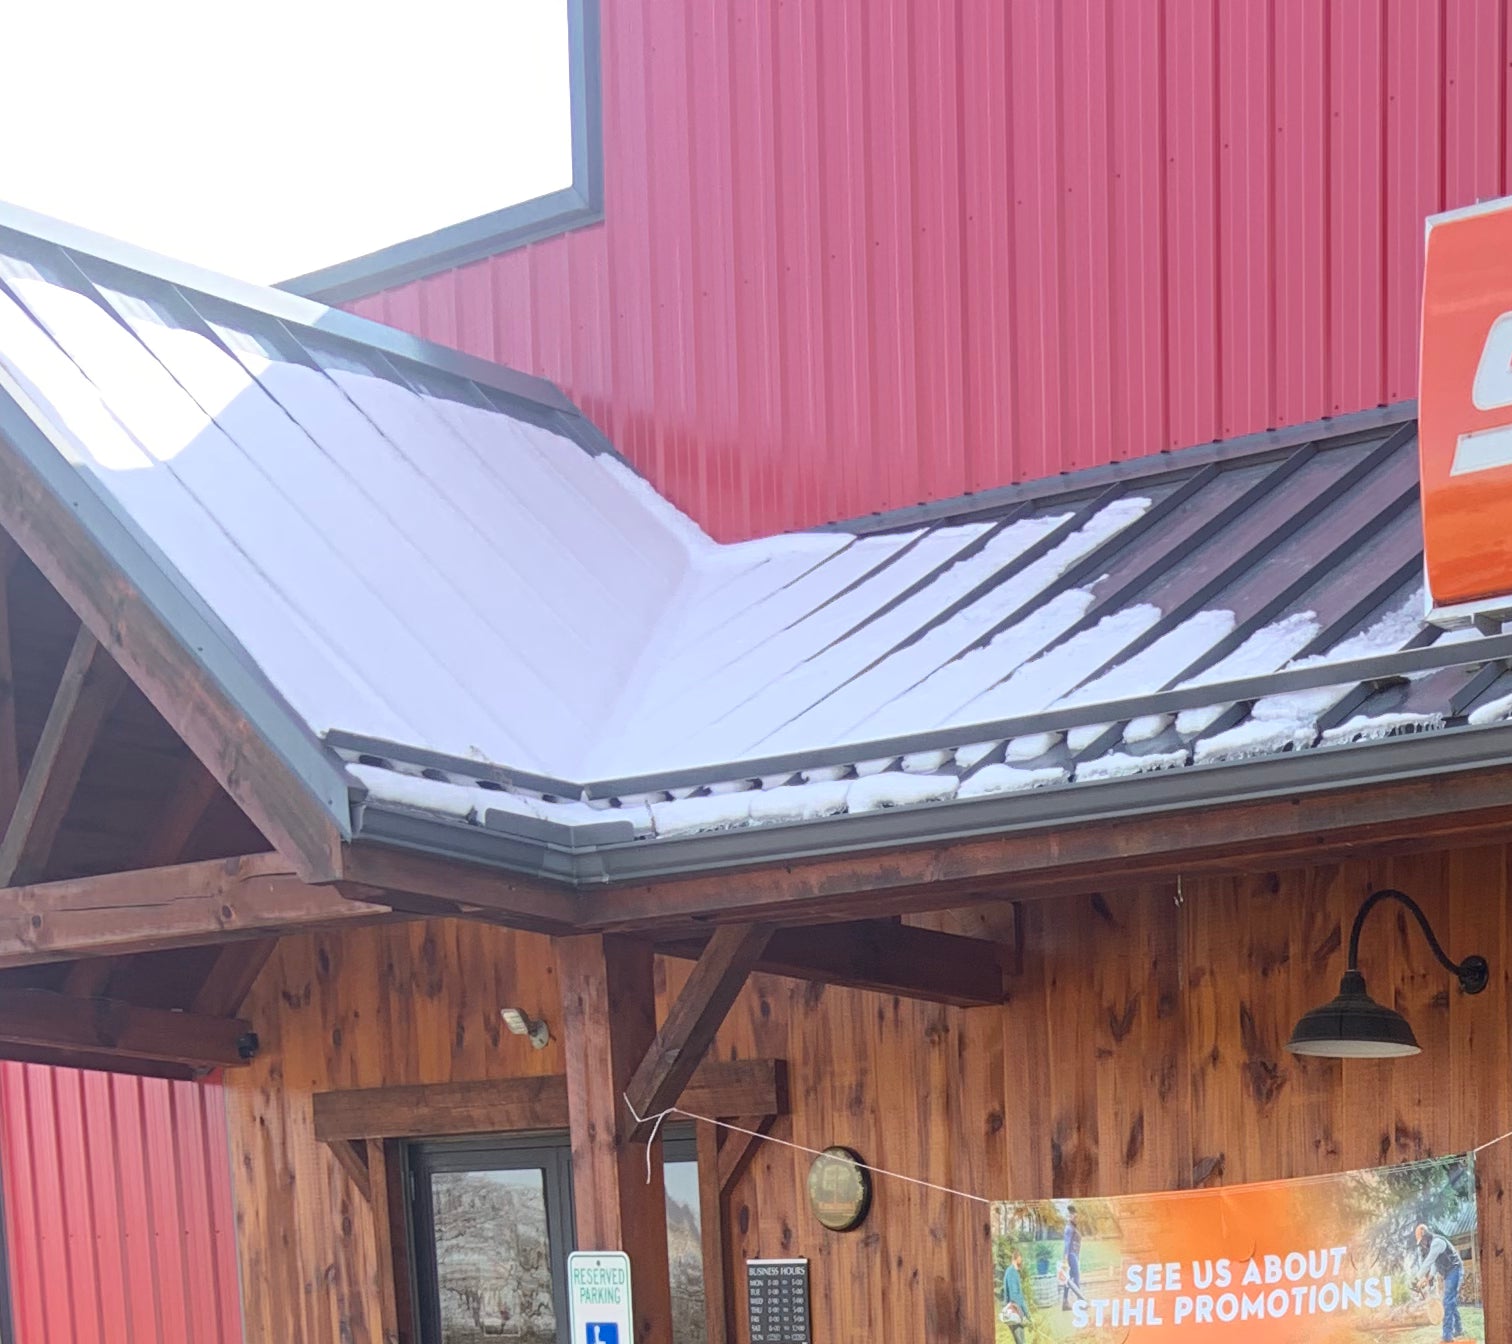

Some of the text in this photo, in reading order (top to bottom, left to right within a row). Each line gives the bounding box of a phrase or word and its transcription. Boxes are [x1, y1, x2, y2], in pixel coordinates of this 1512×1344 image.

[574, 1267, 625, 1285] RESERVED
[749, 1266, 805, 1276] BUSINESS HOURS
[1124, 1245, 1347, 1294] SEE US ABOUT
[580, 1287, 621, 1305] PARKING
[1071, 1276, 1393, 1329] STIHL PROMOTIONS!
